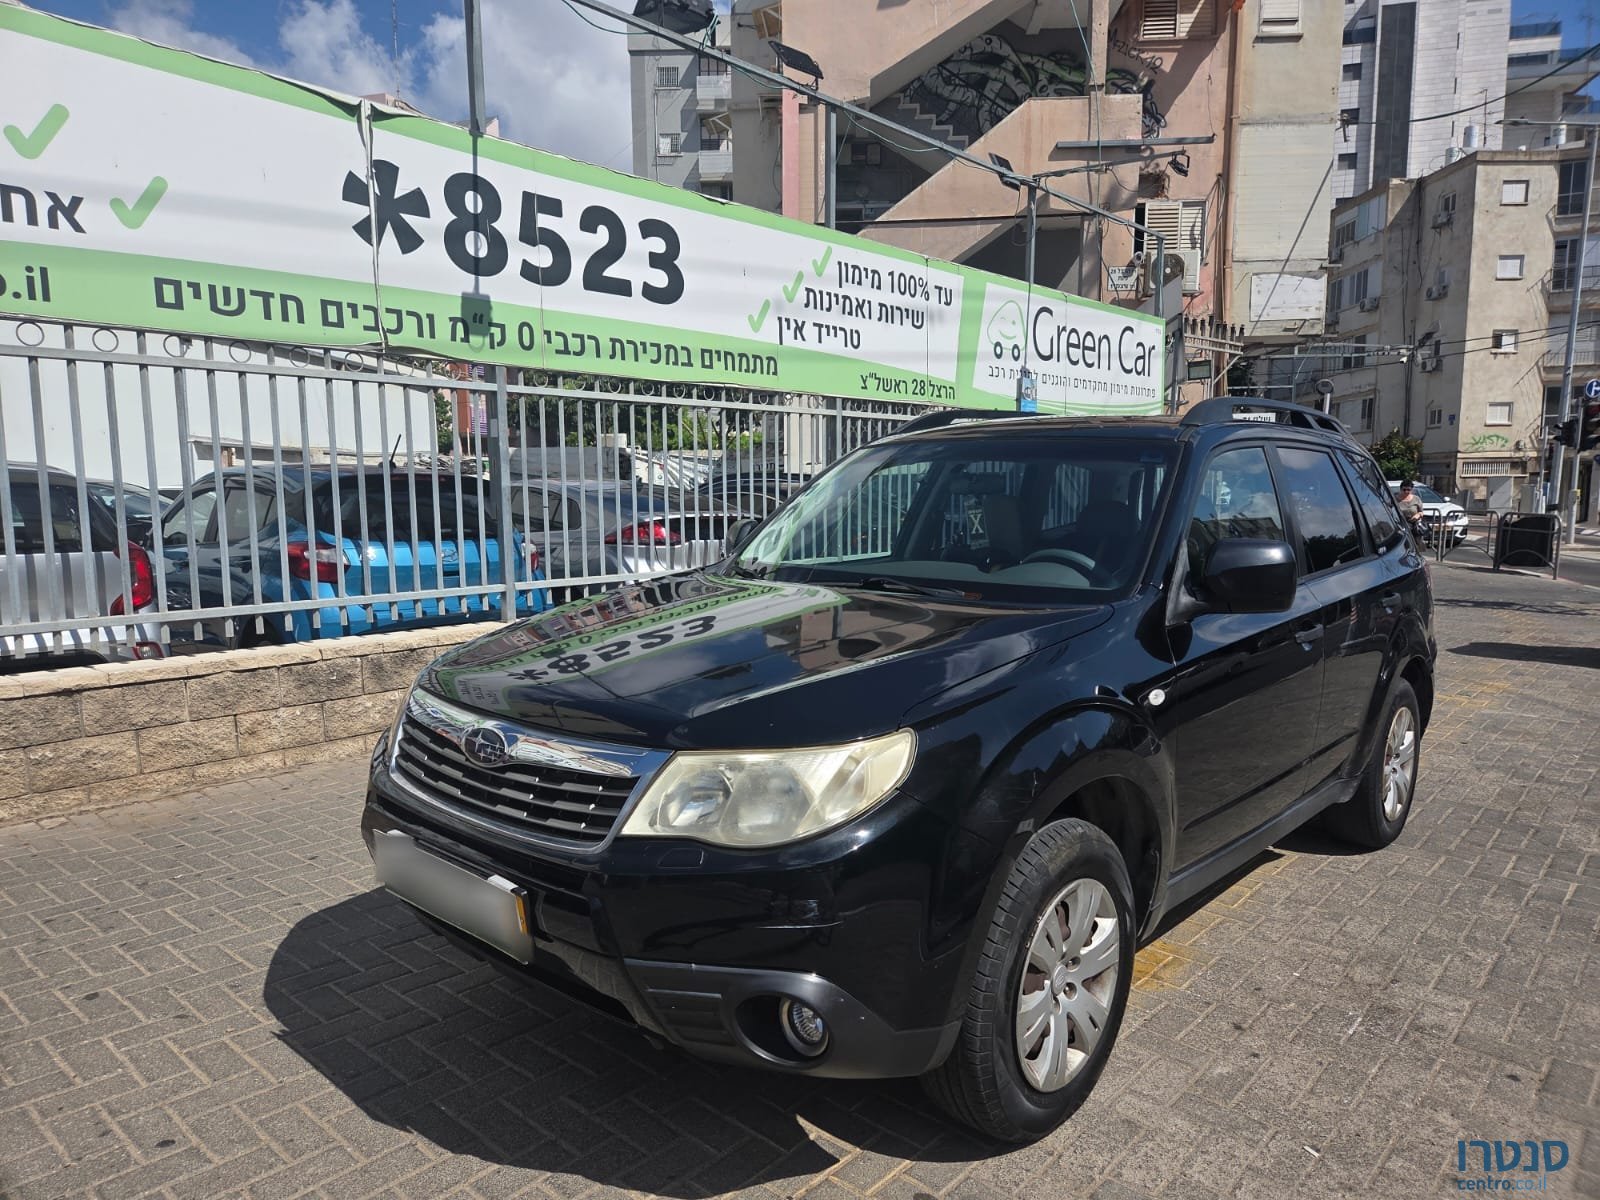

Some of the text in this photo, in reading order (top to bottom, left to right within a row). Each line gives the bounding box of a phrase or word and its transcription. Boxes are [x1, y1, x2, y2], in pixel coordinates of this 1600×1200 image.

[837, 261, 953, 306] עד 100% מימון
[153, 276, 305, 324] חדשים
[804, 287, 924, 329] שירות ואמינות
[320, 297, 435, 339] ורכבים
[777, 316, 861, 349] טרייד אין
[517, 322, 535, 352] 0
[544, 329, 601, 360] רכבי
[1032, 306, 1155, 377] Green Car
[609, 338, 692, 368] במכירת
[700, 347, 778, 377] מתמחים
[988, 365, 1006, 379] רכב
[912, 379, 926, 397] 28
[929, 380, 955, 400] הרצל
